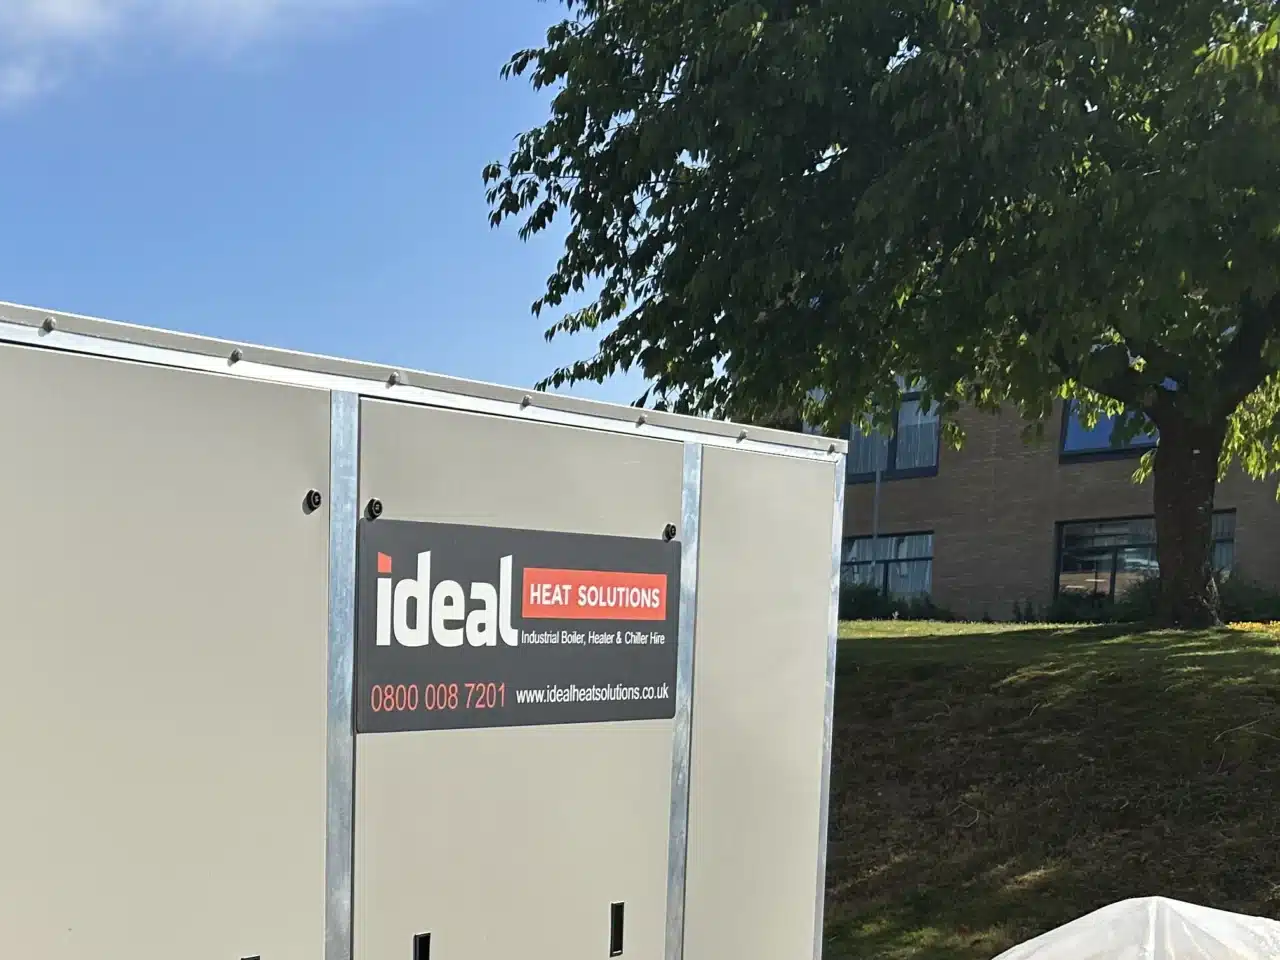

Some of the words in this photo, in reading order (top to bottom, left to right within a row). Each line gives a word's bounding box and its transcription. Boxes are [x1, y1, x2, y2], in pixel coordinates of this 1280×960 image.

[376, 551, 518, 647] ideal
[530, 583, 572, 605] HEAT
[577, 584, 660, 608] SOLUTIONS
[521, 629, 559, 644] Industrial
[561, 630, 586, 646] Boiler,
[588, 630, 614, 645] Heater
[616, 631, 622, 644] &
[624, 631, 648, 645] Chiller
[649, 632, 665, 645] Hire
[371, 684, 418, 712] 0800
[425, 683, 458, 710] 008
[464, 682, 505, 709] 7201
[516, 682, 669, 704] www.idealheatsolutions.co.uk
